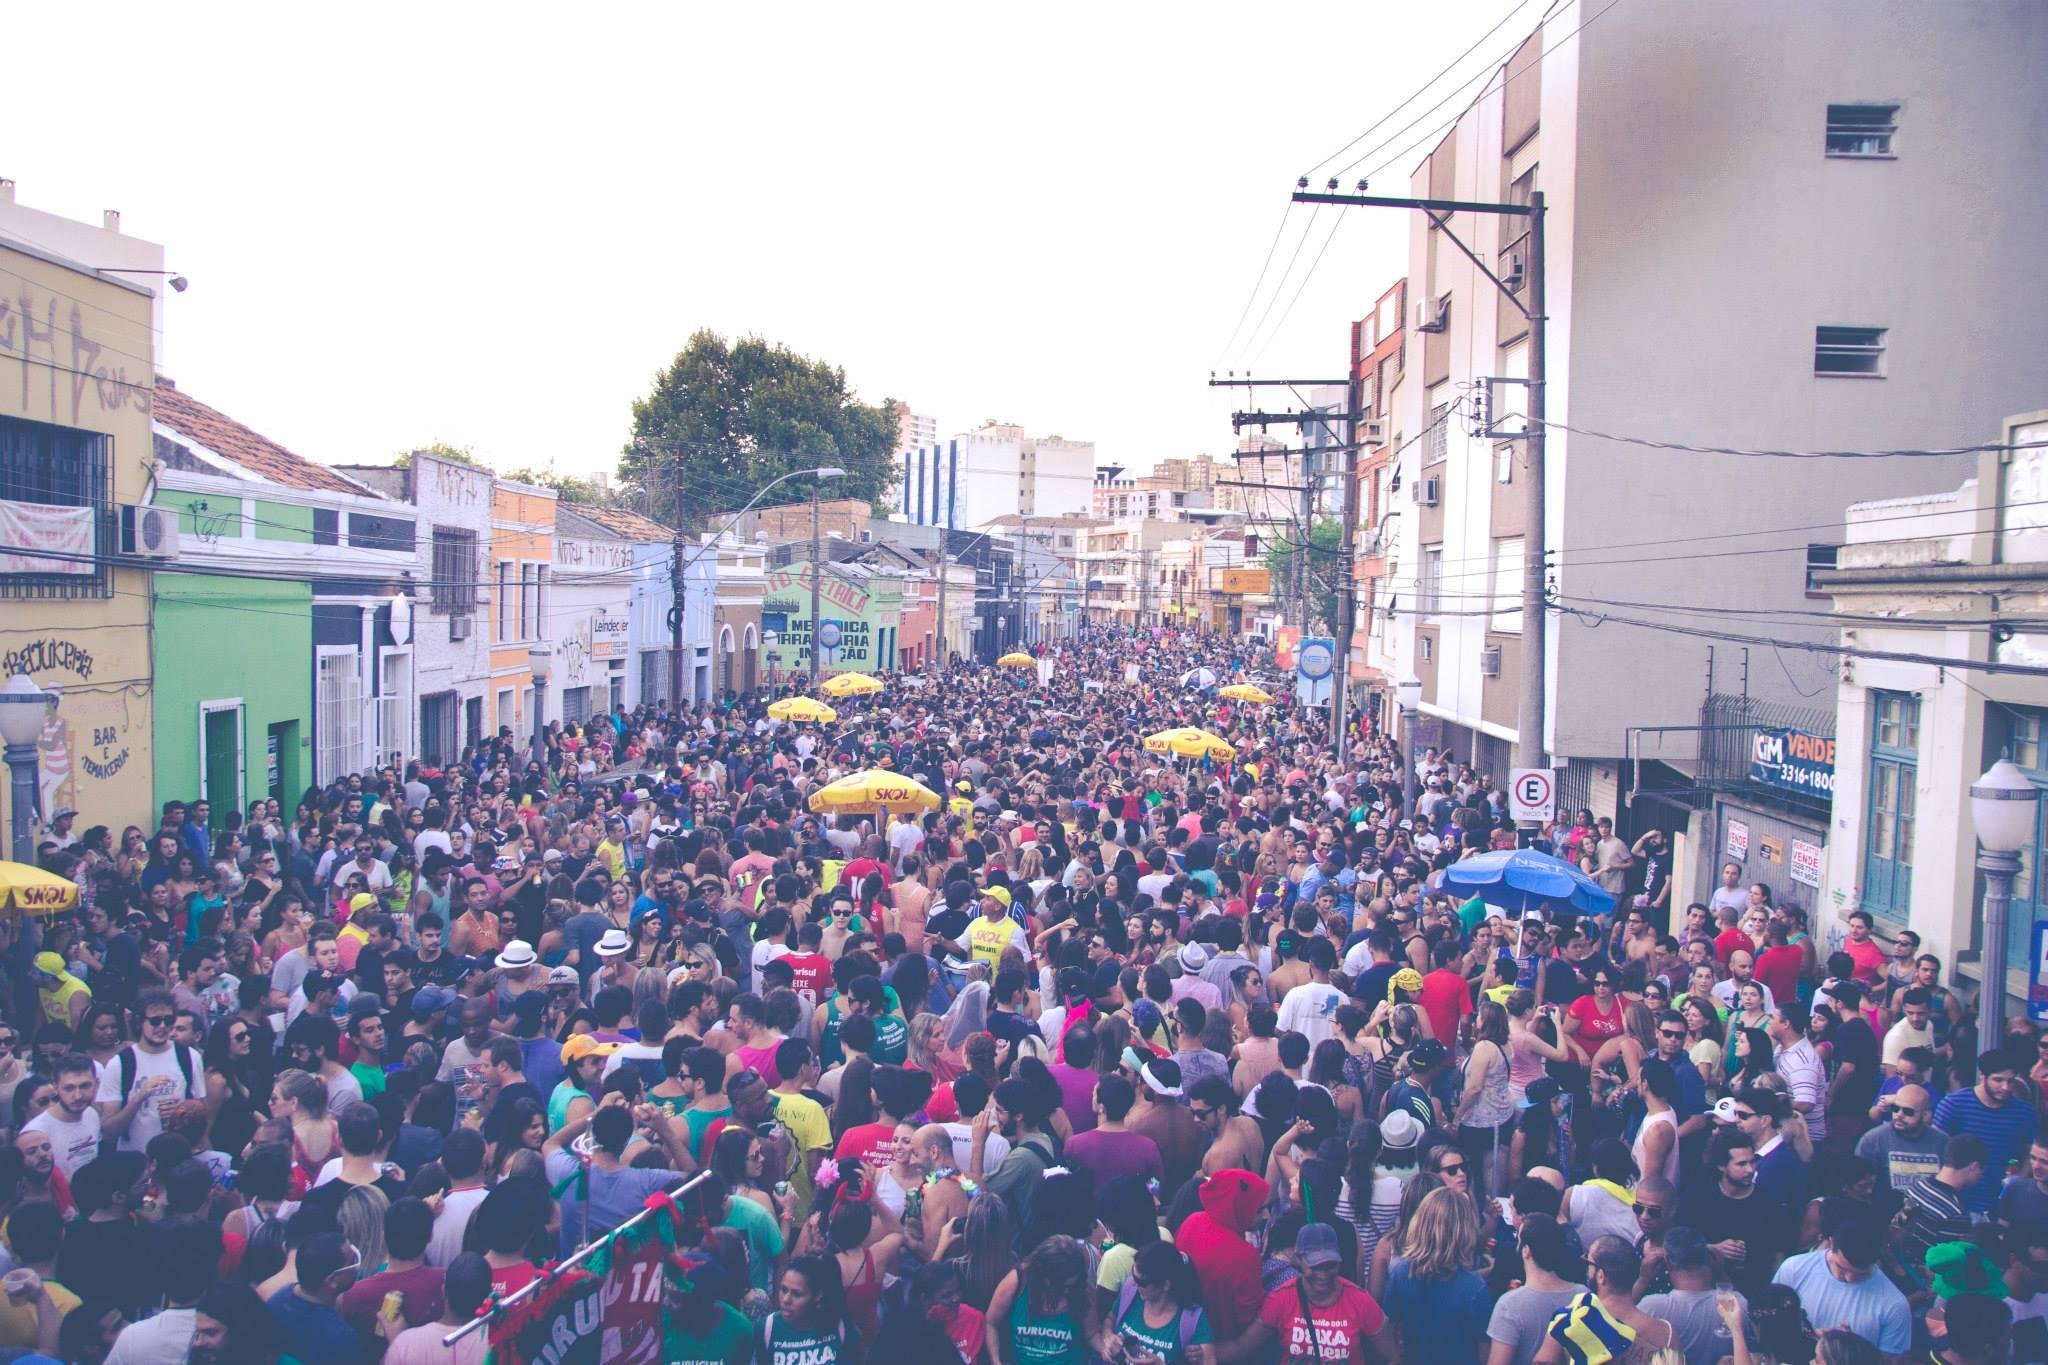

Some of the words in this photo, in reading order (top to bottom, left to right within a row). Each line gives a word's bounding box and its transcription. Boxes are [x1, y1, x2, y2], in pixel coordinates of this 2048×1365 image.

[595, 618, 629, 632] Leindecer
[1304, 655, 1328, 663] NET
[94, 727, 117, 746] BAR
[104, 747, 109, 759] E
[1787, 733, 1836, 764] VENDE
[875, 788, 910, 800] SKOL
[1526, 780, 1539, 800] E
[1793, 850, 1820, 869] VENDE
[24, 886, 68, 905] SKOL
[792, 979, 809, 988] EIXE
[1017, 1325, 1073, 1341] TURUCUTÁ
[773, 1346, 838, 1365] DEIXA
